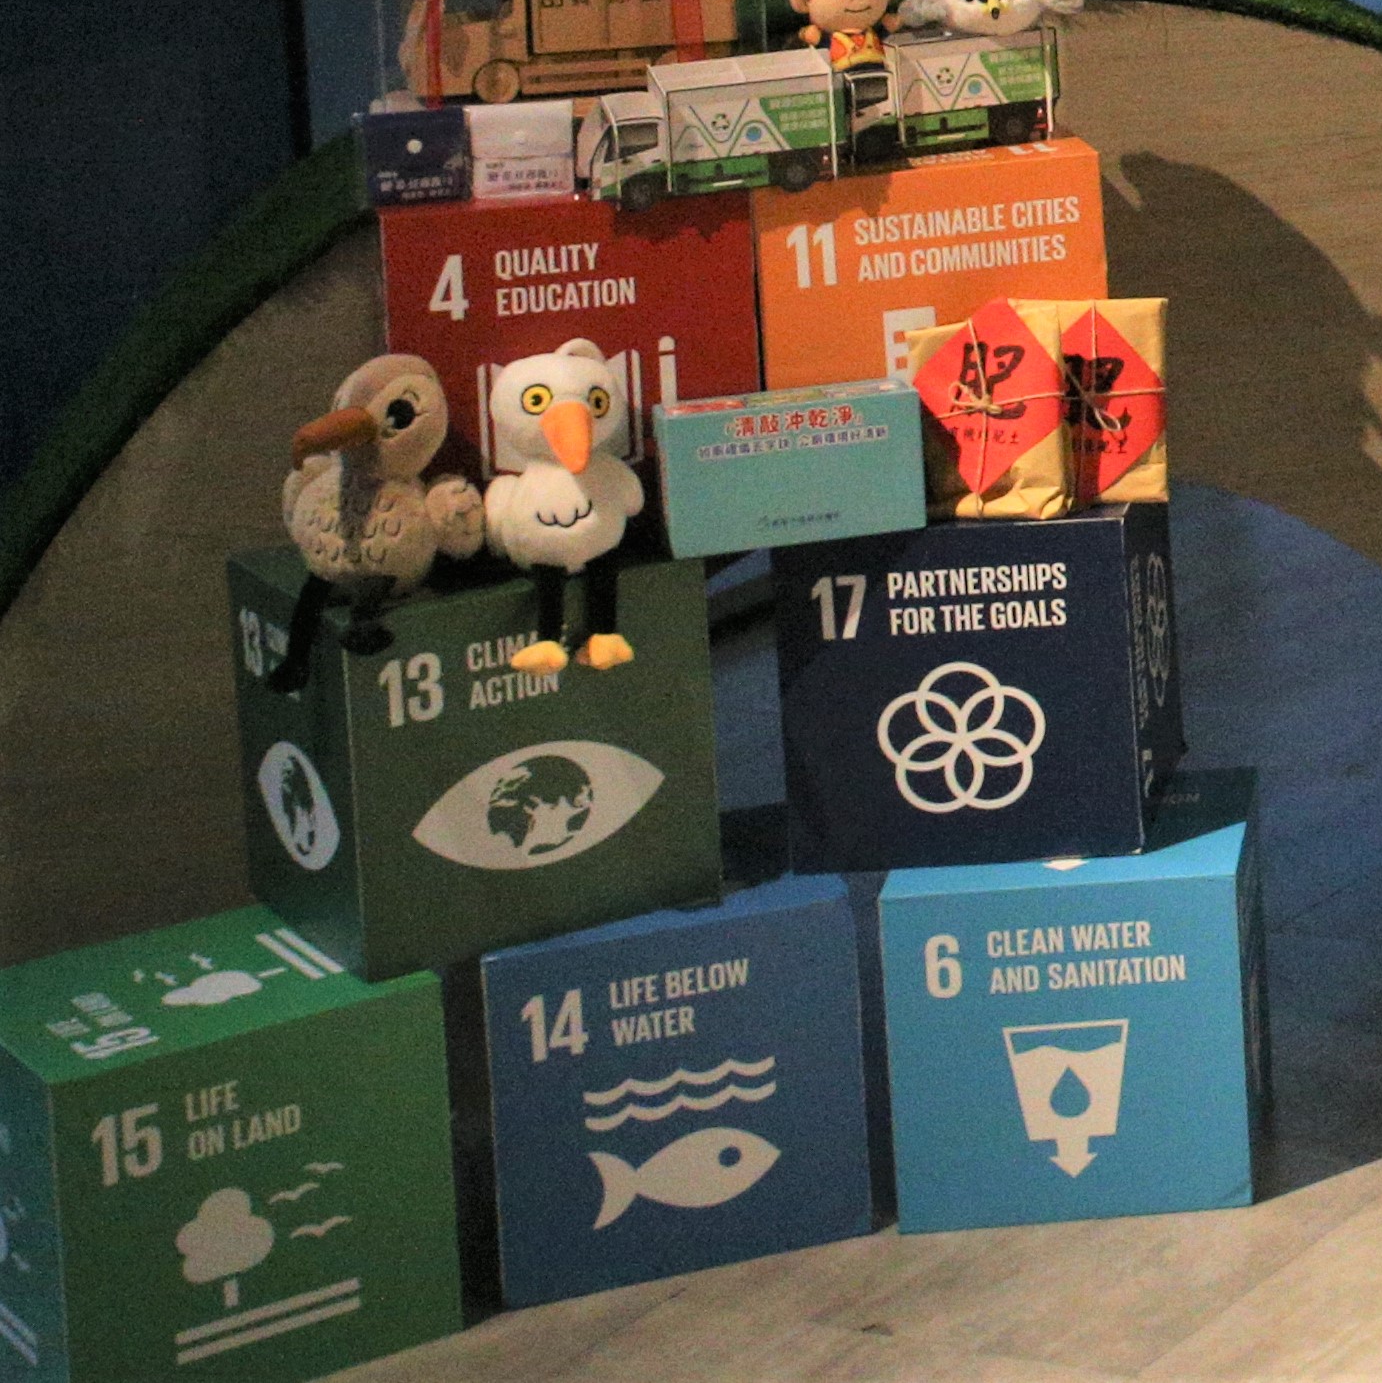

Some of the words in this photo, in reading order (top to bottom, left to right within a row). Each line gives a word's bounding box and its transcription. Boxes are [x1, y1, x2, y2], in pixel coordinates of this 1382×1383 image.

[854, 204, 1006, 246] SUSTAINABLE
[1011, 196, 1081, 229] CITIES
[495, 242, 599, 280] QUALITY
[786, 222, 838, 289] 11
[858, 250, 907, 282] AND
[910, 234, 1067, 277] COMMUNITIES
[429, 254, 469, 321] 4
[496, 276, 636, 316] EDUCATION
[887, 562, 1067, 600] PARTNERSHIPS
[810, 573, 867, 641] 17
[889, 606, 936, 636] FOR
[940, 604, 986, 633] THE
[990, 598, 1067, 630] GOALS
[379, 652, 445, 728] 13
[469, 672, 560, 710] ACTION
[986, 927, 1065, 958] CLEAN
[1071, 920, 1151, 951] WATER
[609, 974, 659, 1010] LIFE
[664, 958, 750, 1000] BELOW
[924, 934, 962, 999] 6
[989, 965, 1040, 995] AND
[1048, 954, 1187, 991] SANITATION
[521, 988, 590, 1063] 14
[611, 1006, 696, 1047] WATER
[185, 1080, 240, 1123] LIFE
[91, 1103, 163, 1187] 15
[187, 1125, 226, 1161] ON
[232, 1103, 302, 1151] LAND
